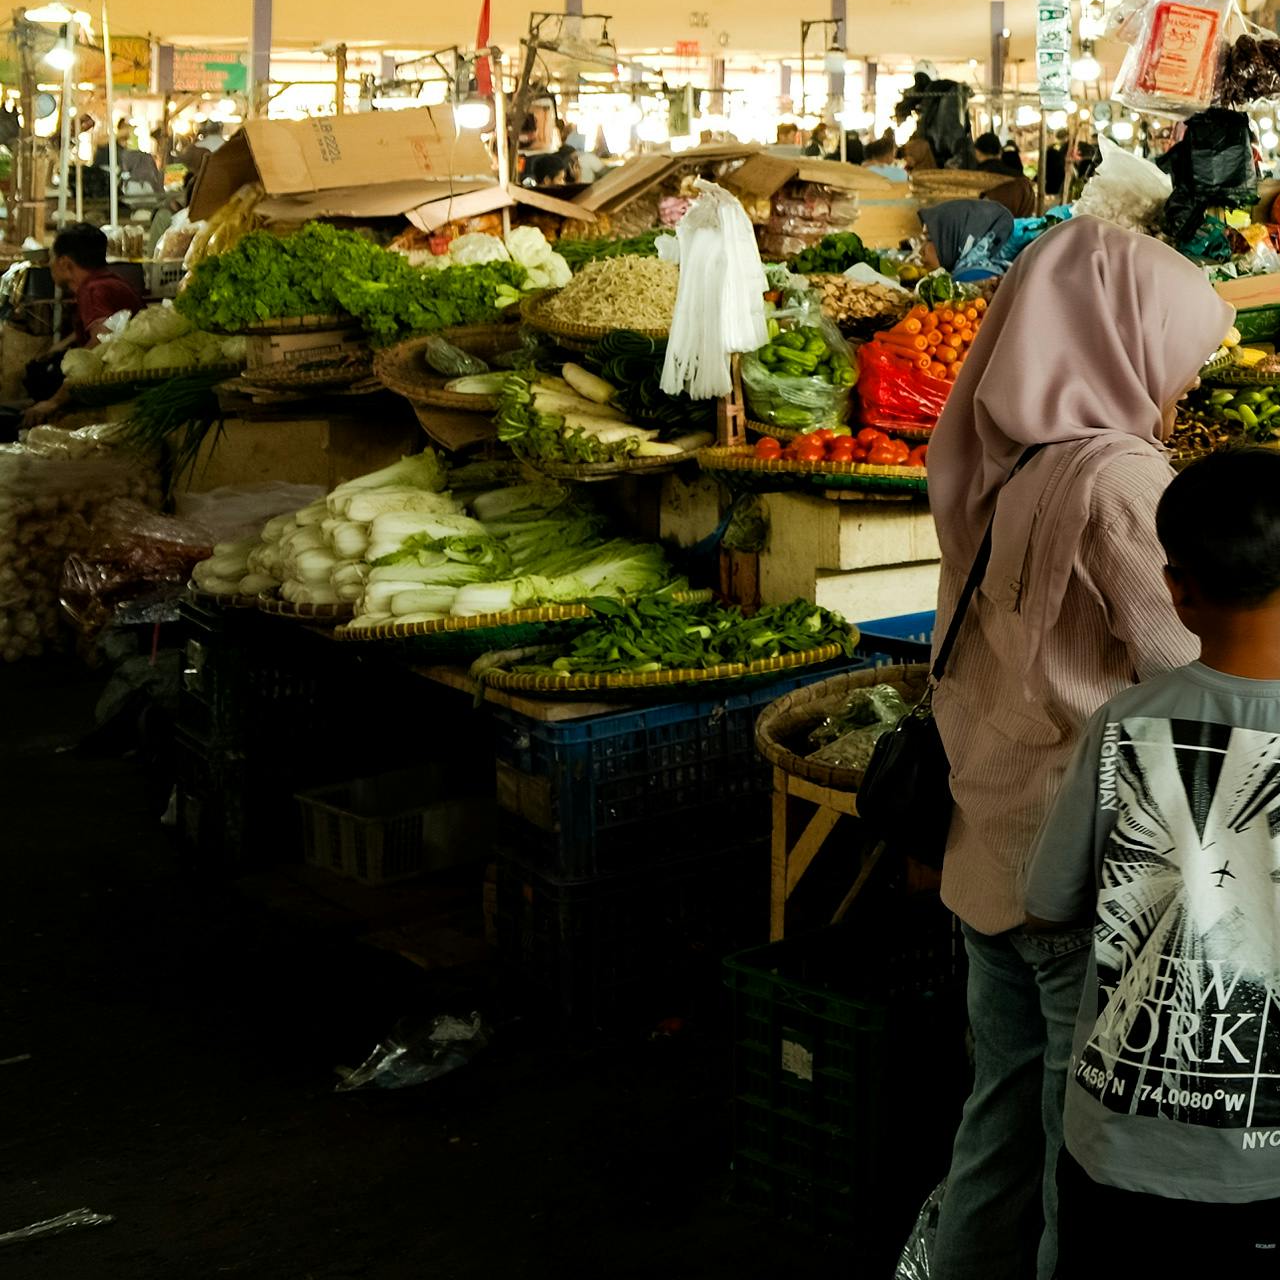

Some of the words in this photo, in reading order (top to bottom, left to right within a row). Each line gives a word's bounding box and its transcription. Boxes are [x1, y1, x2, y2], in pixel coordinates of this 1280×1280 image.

[1100, 722, 1120, 811] HIGHWAY
[1114, 940, 1252, 1011] NEW
[1100, 984, 1257, 1064] YORK
[1140, 1084, 1246, 1112] 74.0080°W
